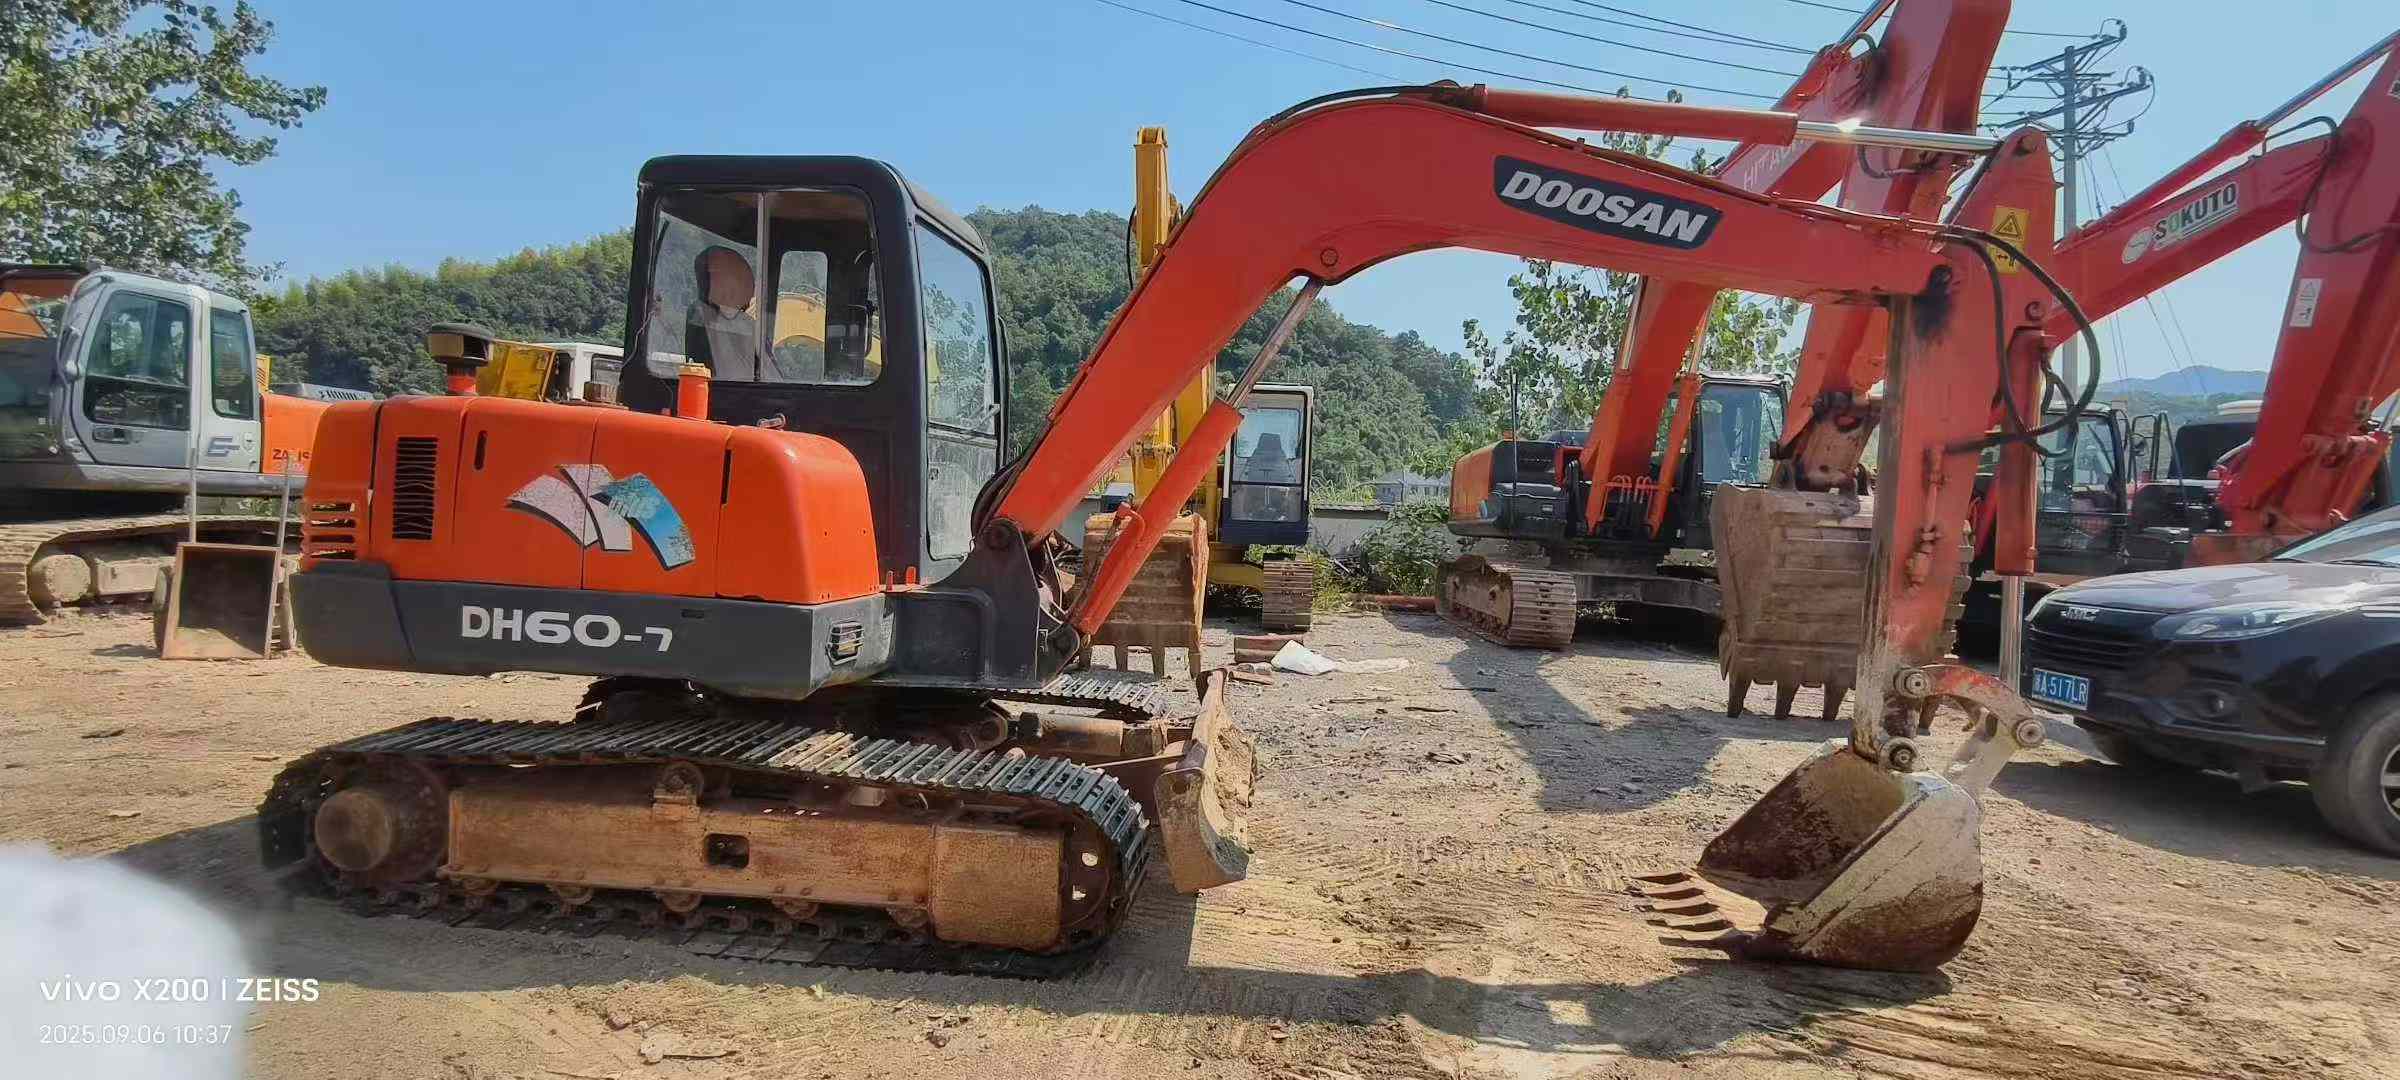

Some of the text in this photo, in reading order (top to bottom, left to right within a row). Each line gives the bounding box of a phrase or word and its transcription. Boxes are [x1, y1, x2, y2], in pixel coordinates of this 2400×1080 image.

[1500, 170, 1708, 243] DOOSAN
[2155, 182, 2237, 241] SOKUTO
[461, 604, 674, 653] DH60-7
